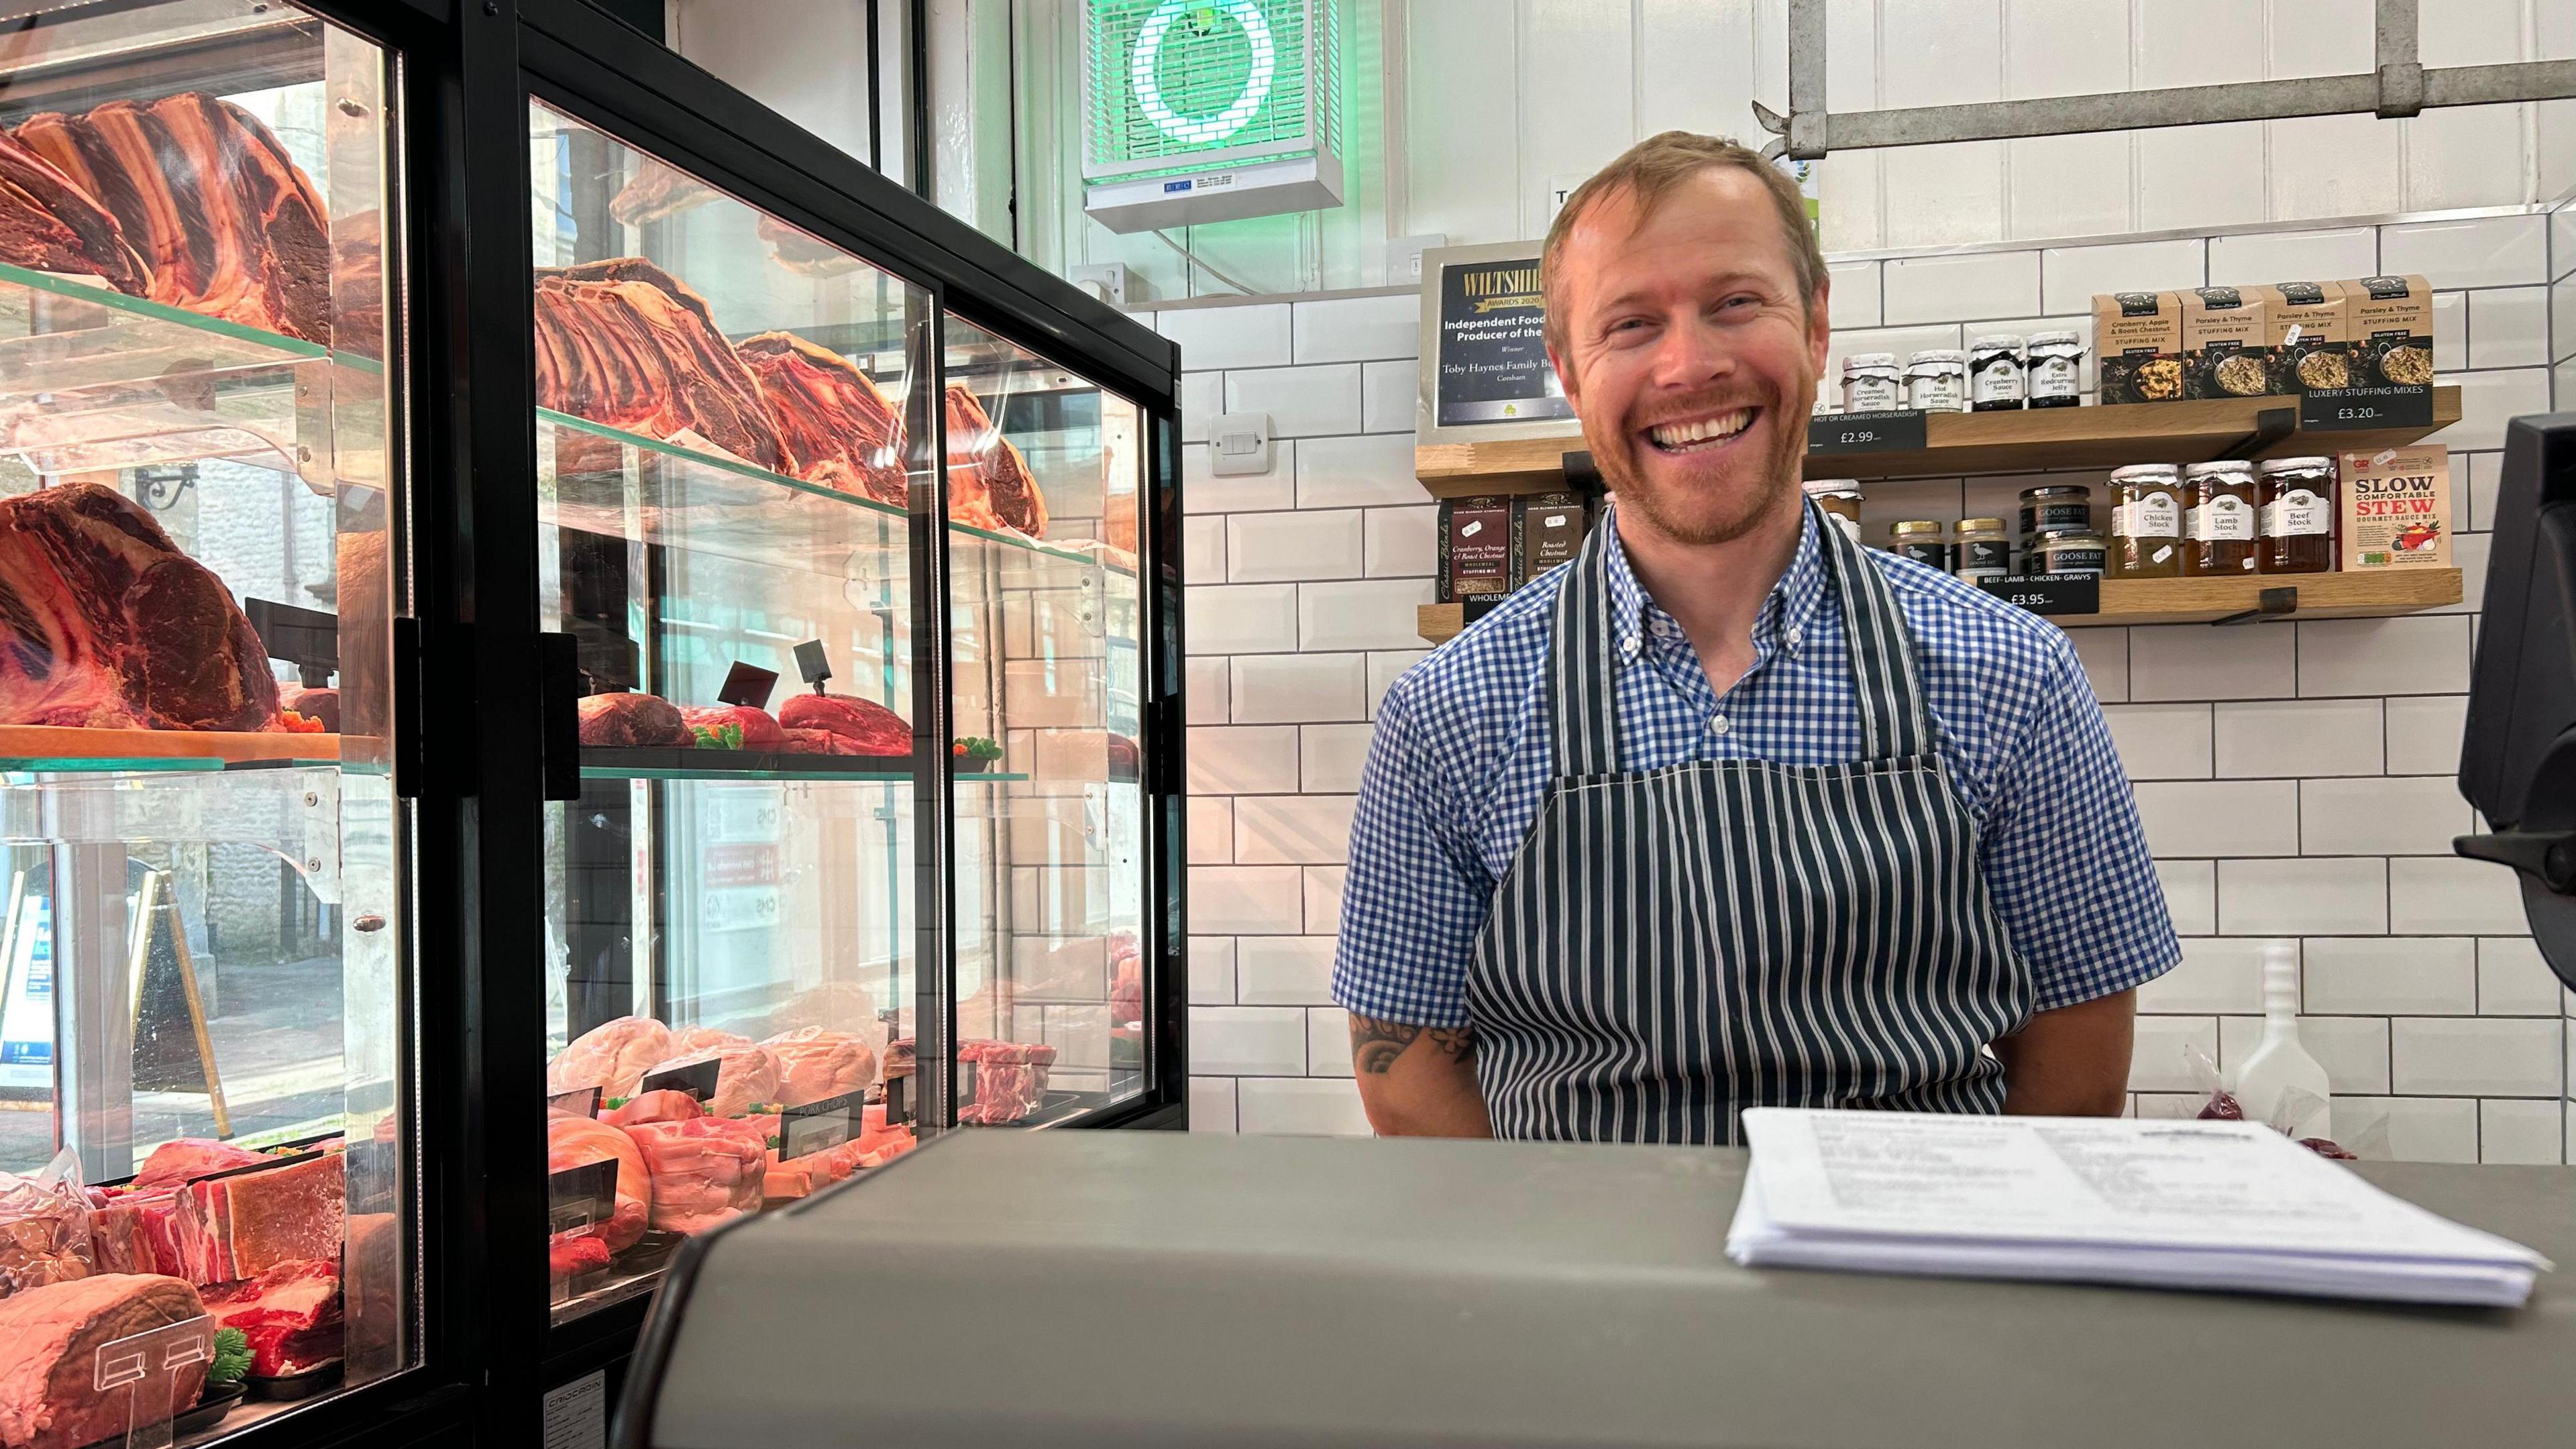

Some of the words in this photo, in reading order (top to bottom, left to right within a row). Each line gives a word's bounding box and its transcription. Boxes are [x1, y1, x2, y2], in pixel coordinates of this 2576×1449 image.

[1487, 299, 1519, 307] AWARDS
[1521, 297, 1540, 305] 2020
[2312, 311, 2335, 319] Thyme
[2361, 307, 2386, 315] Parsley
[1444, 317, 1516, 330] Independent
[1518, 314, 1546, 325] Food
[2363, 317, 2400, 325] STUFFING
[1457, 331, 1509, 341] Producer
[1509, 329, 1522, 338] of
[1523, 327, 1542, 337] the
[1442, 364, 1466, 375] Toby
[1469, 363, 1503, 374] Haynes
[1507, 358, 1538, 370] Family
[1497, 374, 1525, 382] Corsham
[2309, 388, 2343, 398] LUXERY
[2345, 386, 2392, 396] STUFFING
[2394, 385, 2424, 394] MIXES
[1851, 394, 1890, 402] Horseradish
[1839, 413, 1871, 421] CREAMED
[1872, 411, 1917, 419] HORSERADISH
[2338, 407, 2374, 419] £3.20
[1840, 431, 1873, 443] £2.99
[2353, 459, 2370, 468] GR
[2355, 476, 2434, 494] SLOW
[2355, 491, 2436, 501] COMFORTABLE
[2039, 508, 2071, 517] GOOSE
[2073, 507, 2086, 516] FAT
[2356, 498, 2436, 517] STEW
[2288, 518, 2312, 526] Stock
[1440, 525, 1450, 559] Blends
[1542, 540, 1566, 548] Roasted
[1452, 545, 1483, 553] Cranberry,
[1485, 544, 1506, 553] Orange
[1540, 549, 1568, 557] Chestnut
[1479, 551, 1505, 559] Chestnut
[2053, 552, 2087, 561] GOOSE
[2089, 551, 2102, 560] FAT
[1441, 559, 1450, 600] Classic
[2011, 594, 2045, 605] £3.95
[800, 1104, 820, 1116] PORK
[822, 1096, 847, 1111] CHOPS
